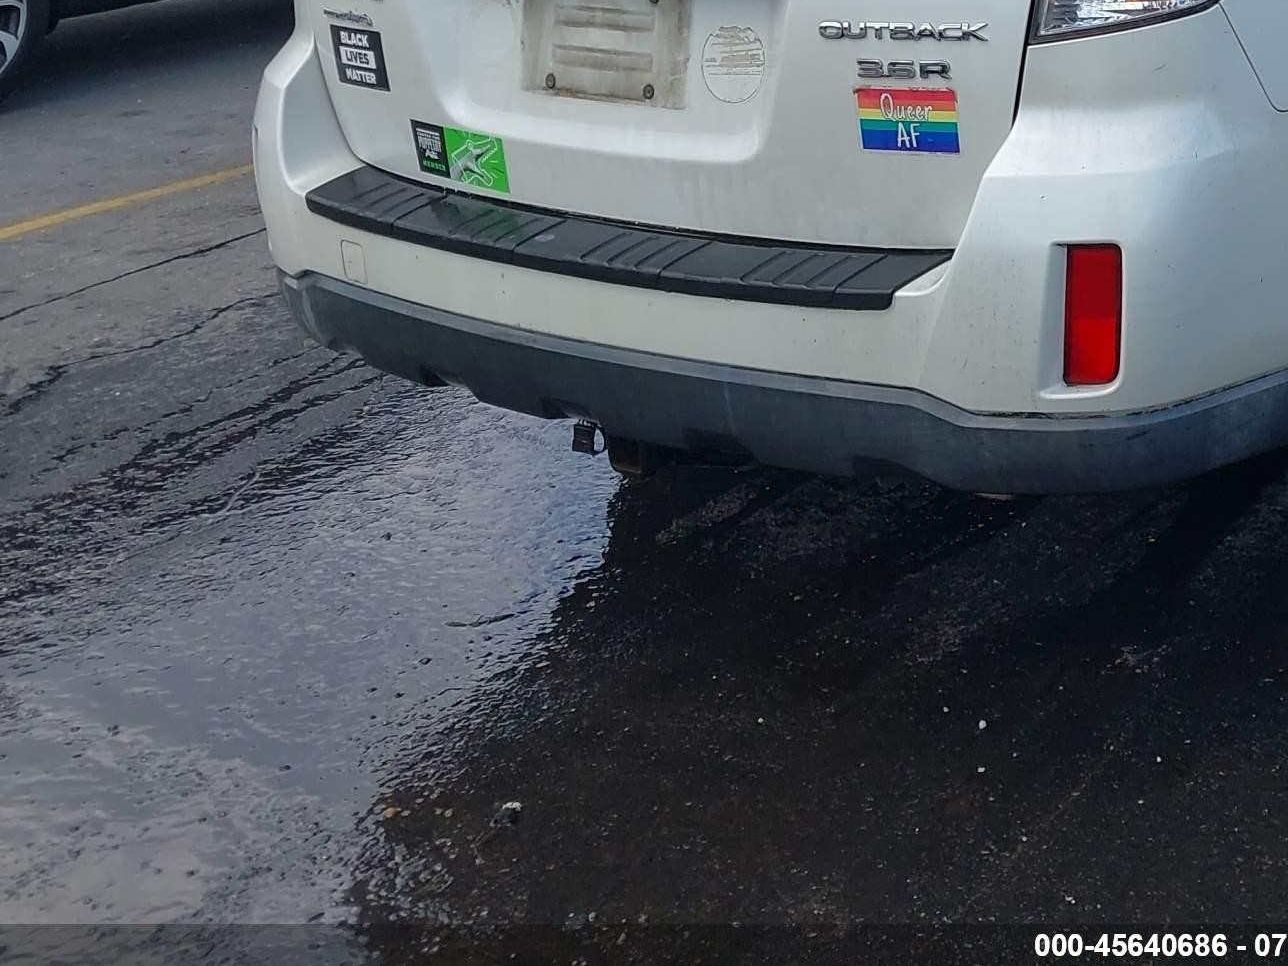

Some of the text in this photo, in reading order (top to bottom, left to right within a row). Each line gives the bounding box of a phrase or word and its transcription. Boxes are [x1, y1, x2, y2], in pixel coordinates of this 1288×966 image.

[340, 31, 369, 47] BLACK
[818, 19, 989, 42] OUTBACK
[345, 50, 370, 65] LIVES
[345, 68, 377, 84] MATTER
[880, 92, 932, 121] Queer
[897, 122, 920, 149] AF
